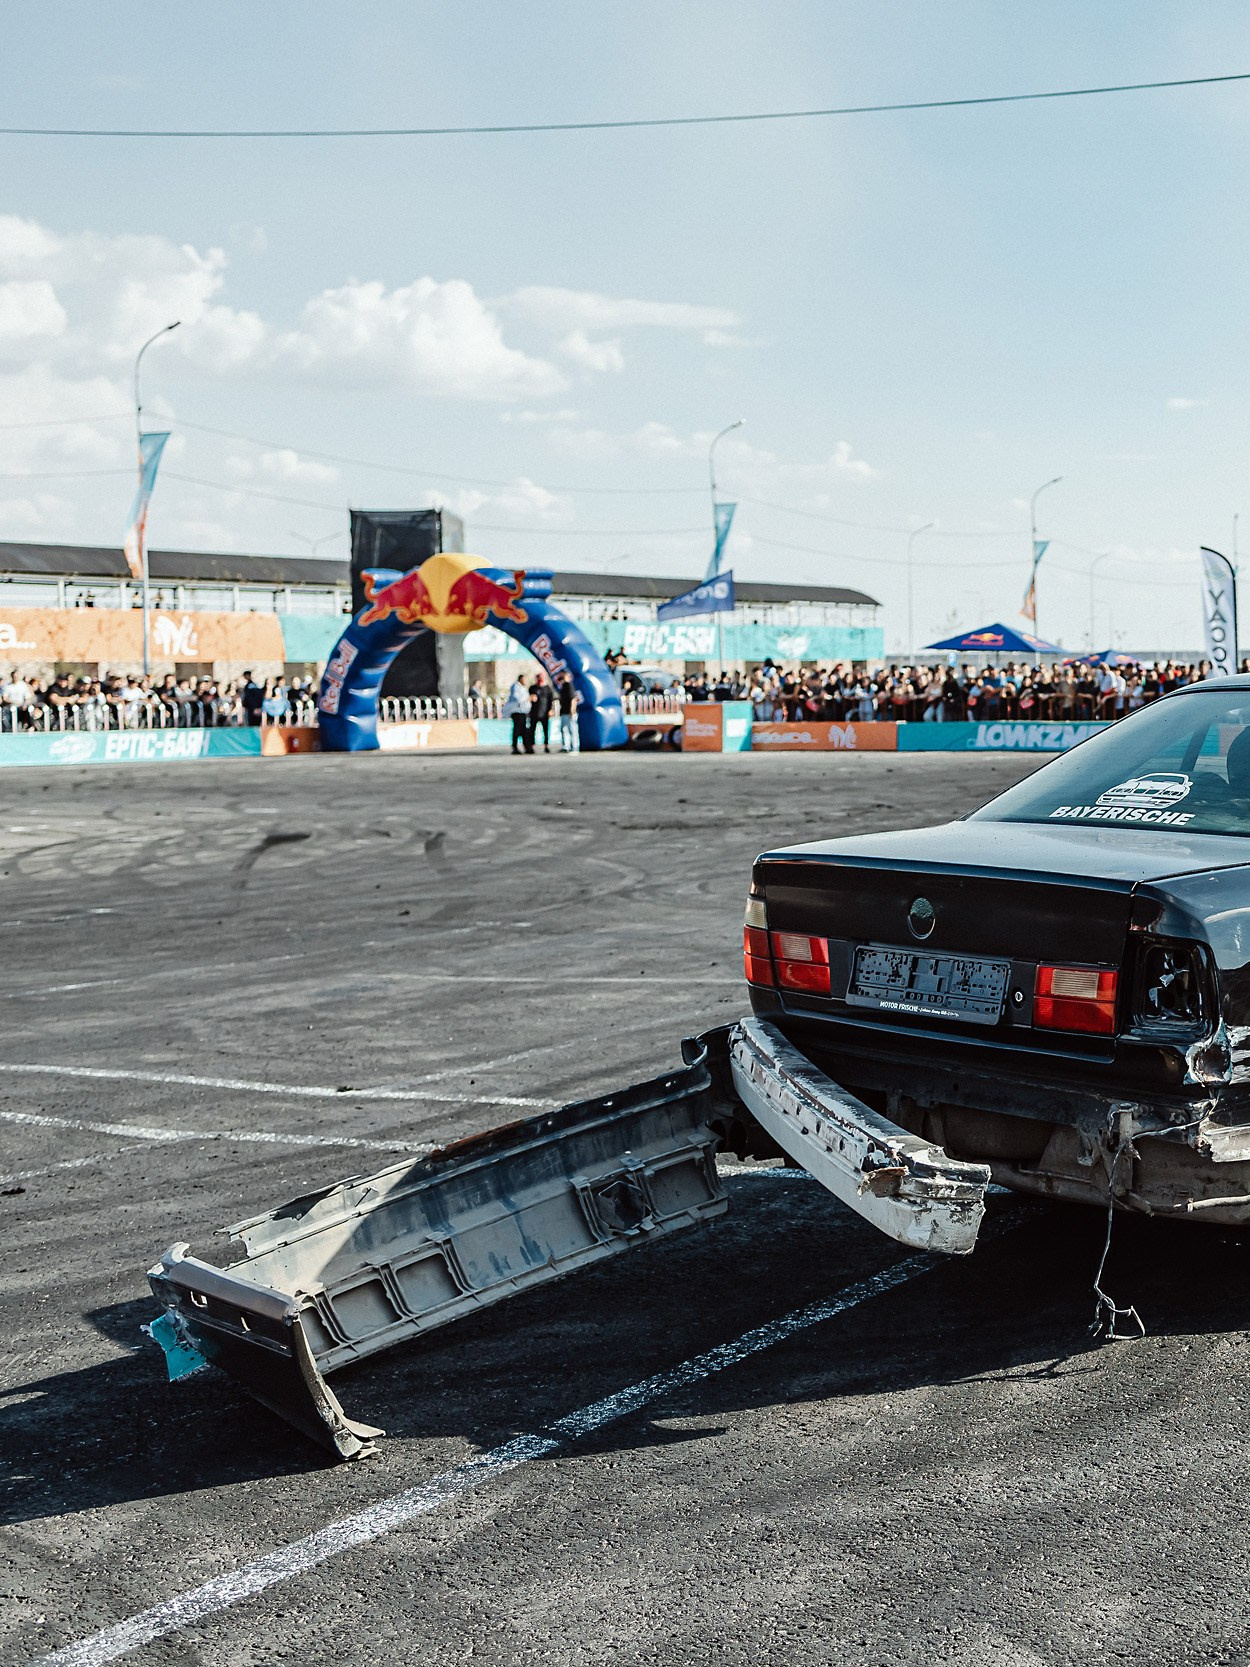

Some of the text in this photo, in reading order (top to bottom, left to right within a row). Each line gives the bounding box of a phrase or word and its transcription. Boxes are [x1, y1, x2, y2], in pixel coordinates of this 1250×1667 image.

[531, 633, 567, 676] Red
[320, 671, 345, 714] Red
[1049, 806, 1196, 826] BAYERISCHE
[880, 1001, 898, 1010] MOTOR
